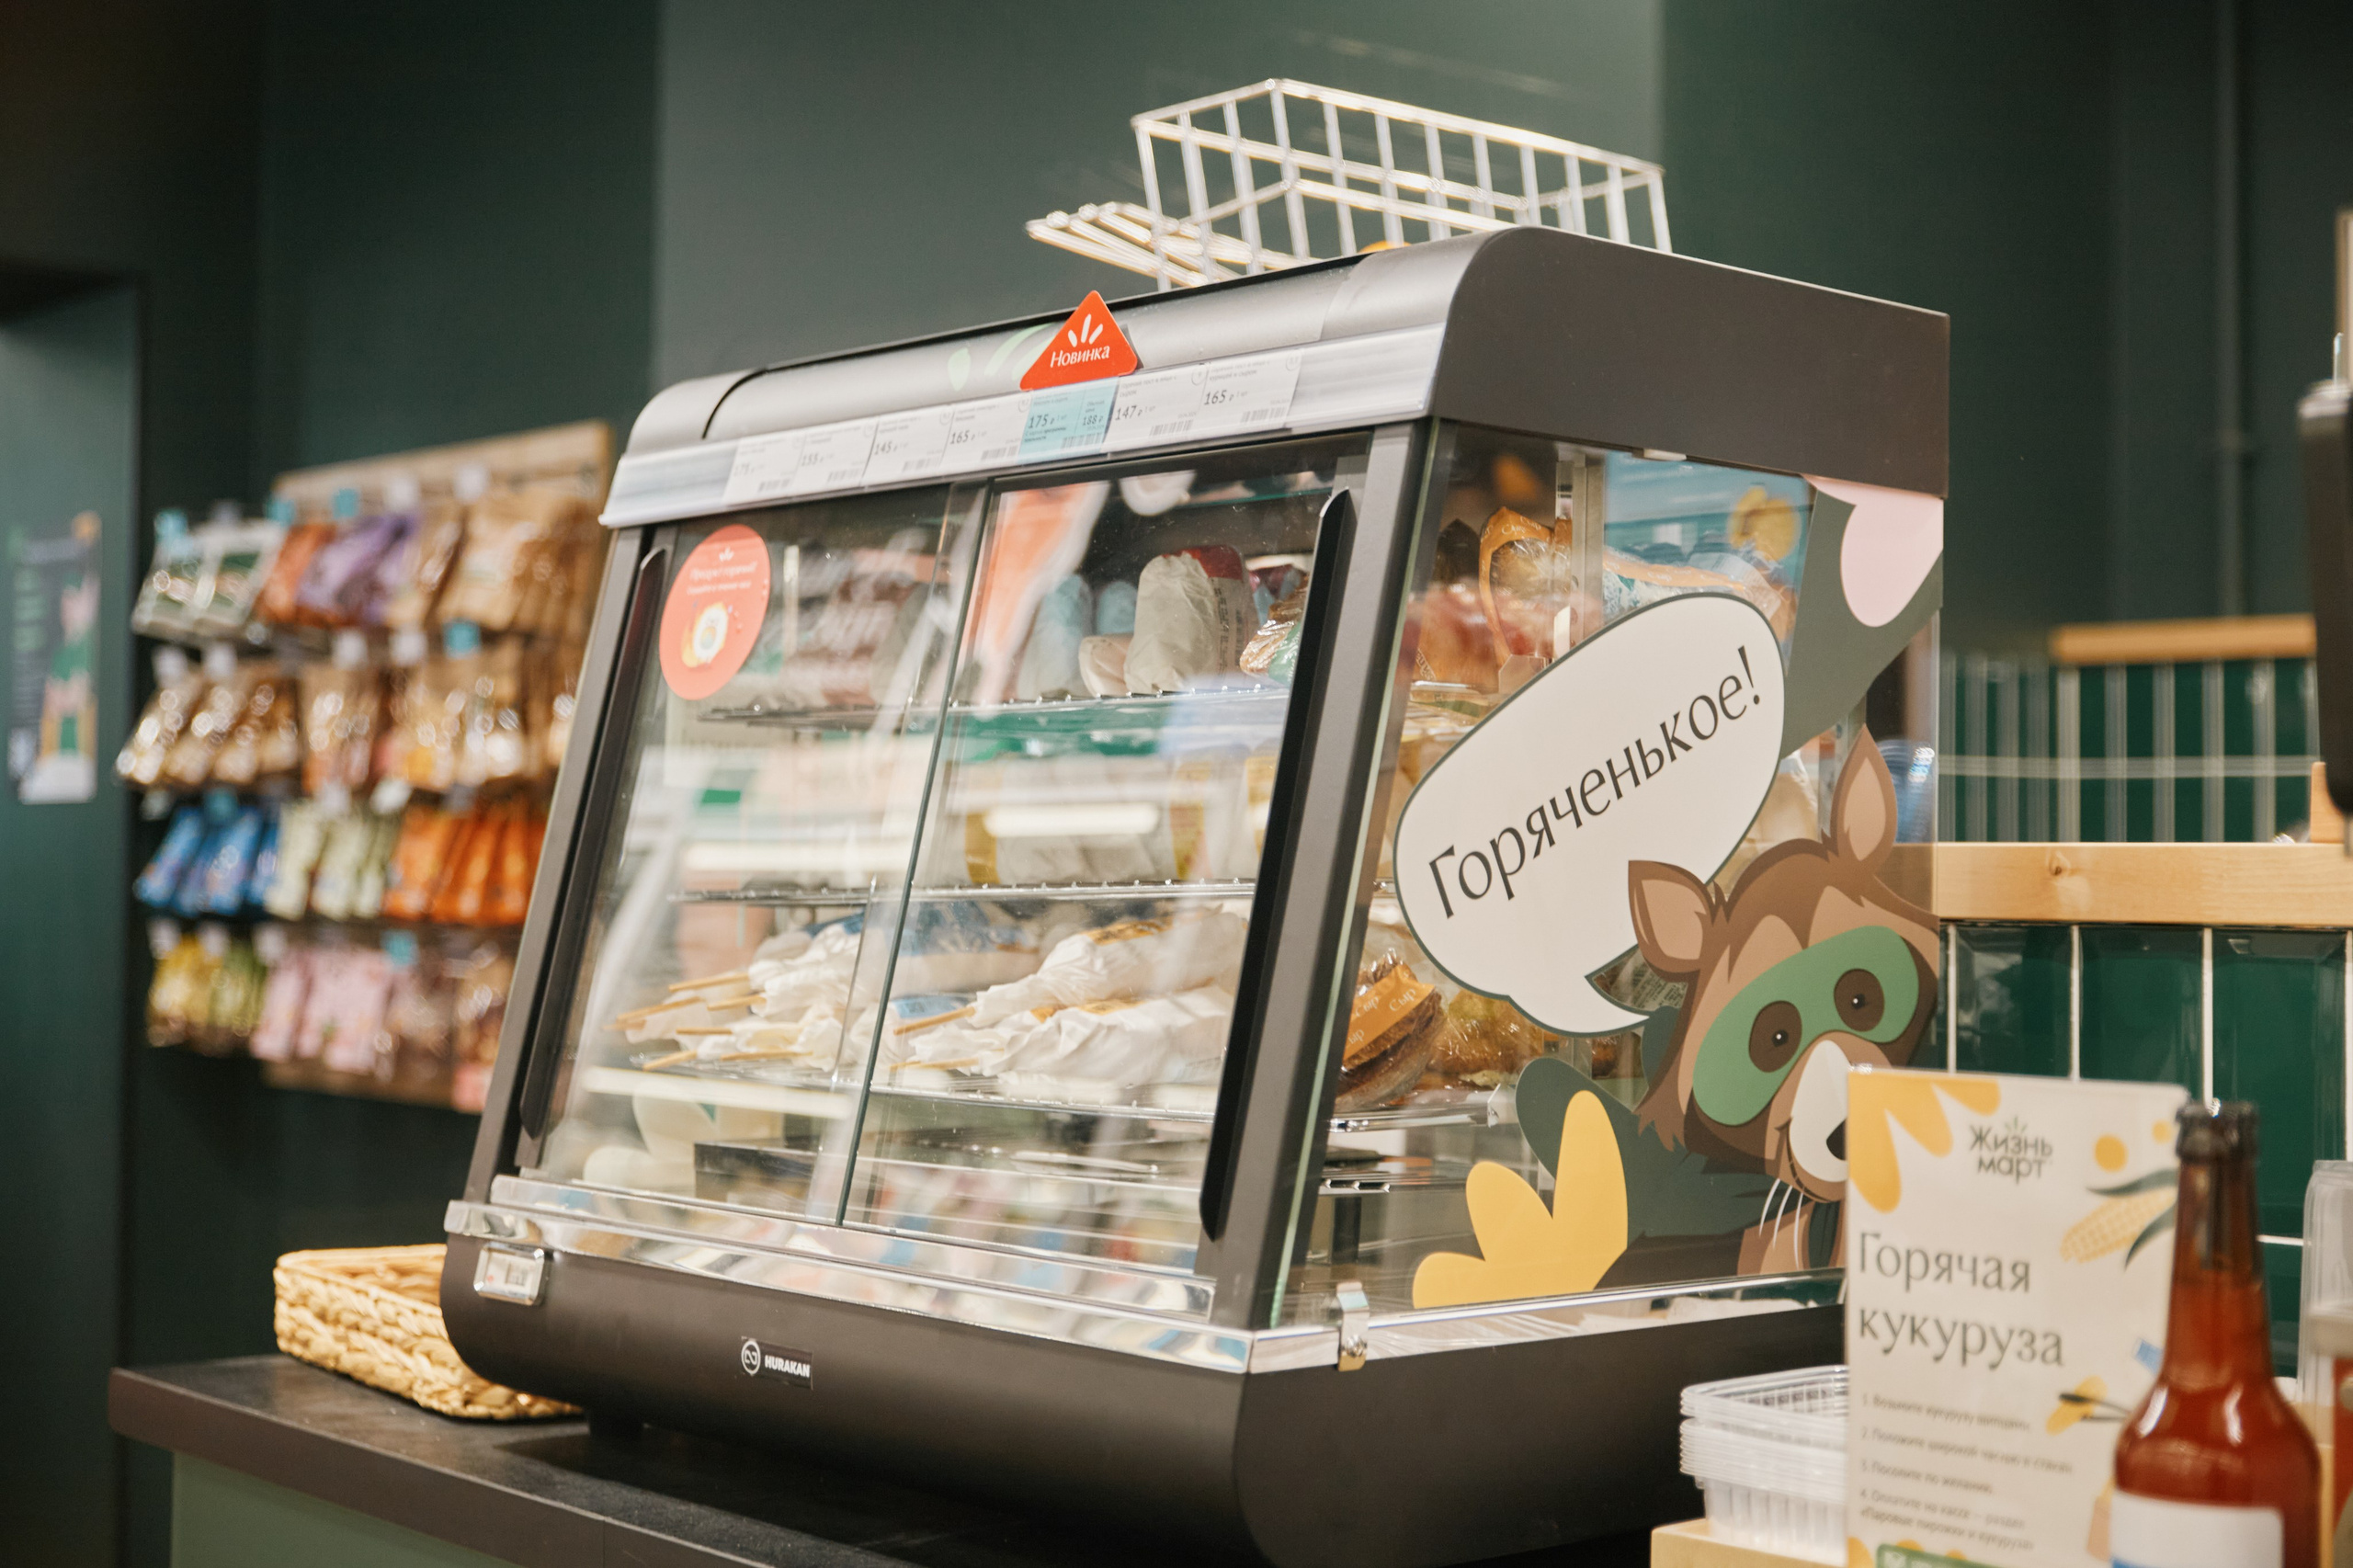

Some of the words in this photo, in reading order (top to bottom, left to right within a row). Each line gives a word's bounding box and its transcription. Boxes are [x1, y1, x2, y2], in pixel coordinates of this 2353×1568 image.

[1050, 345, 1111, 369] Новинка
[1203, 390, 1227, 405] 165
[1028, 414, 1049, 429] 175
[1115, 405, 1137, 421] 147
[949, 430, 970, 445] 165
[1428, 645, 1761, 919] Горяченькое!
[1389, 988, 1416, 1012] Сыр
[1969, 1123, 2053, 1157] Жизнь
[1977, 1154, 2047, 1186] март
[1859, 1231, 2032, 1293] Горячая
[1859, 1307, 2064, 1370] кукуруза
[764, 1354, 811, 1379] HURAKAN
